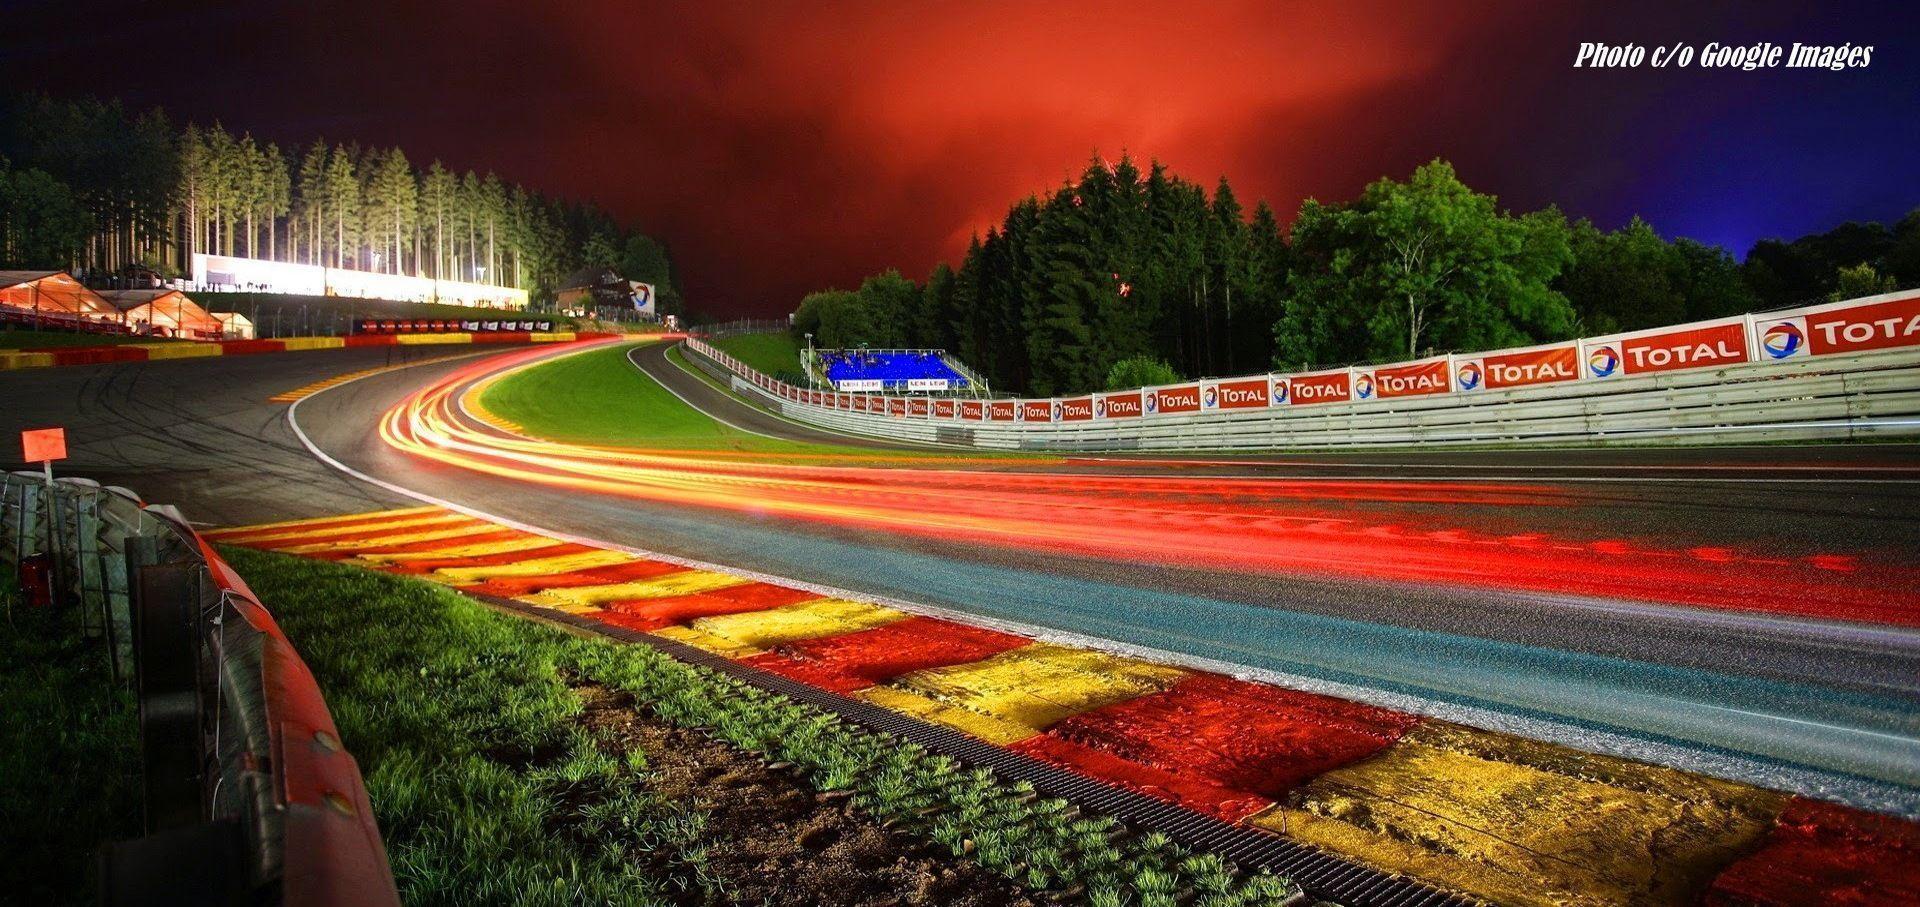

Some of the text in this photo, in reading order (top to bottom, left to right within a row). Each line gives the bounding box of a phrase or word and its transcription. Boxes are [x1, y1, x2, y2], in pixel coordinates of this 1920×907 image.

[1627, 341, 1740, 367] TOTAL
[1488, 361, 1573, 383] TOTAL
[1379, 373, 1445, 392] TOTAL
[1221, 388, 1266, 403] TOTAL
[1293, 384, 1347, 399] TOTAL
[1160, 394, 1198, 407] TOTAL
[936, 404, 953, 415] TOTAL
[962, 405, 982, 416] TOTAL
[992, 406, 1014, 417] TOTAL
[1025, 408, 1050, 418] TOTAL
[1063, 405, 1091, 416] TOTAL
[1107, 401, 1140, 413] TOTAL
